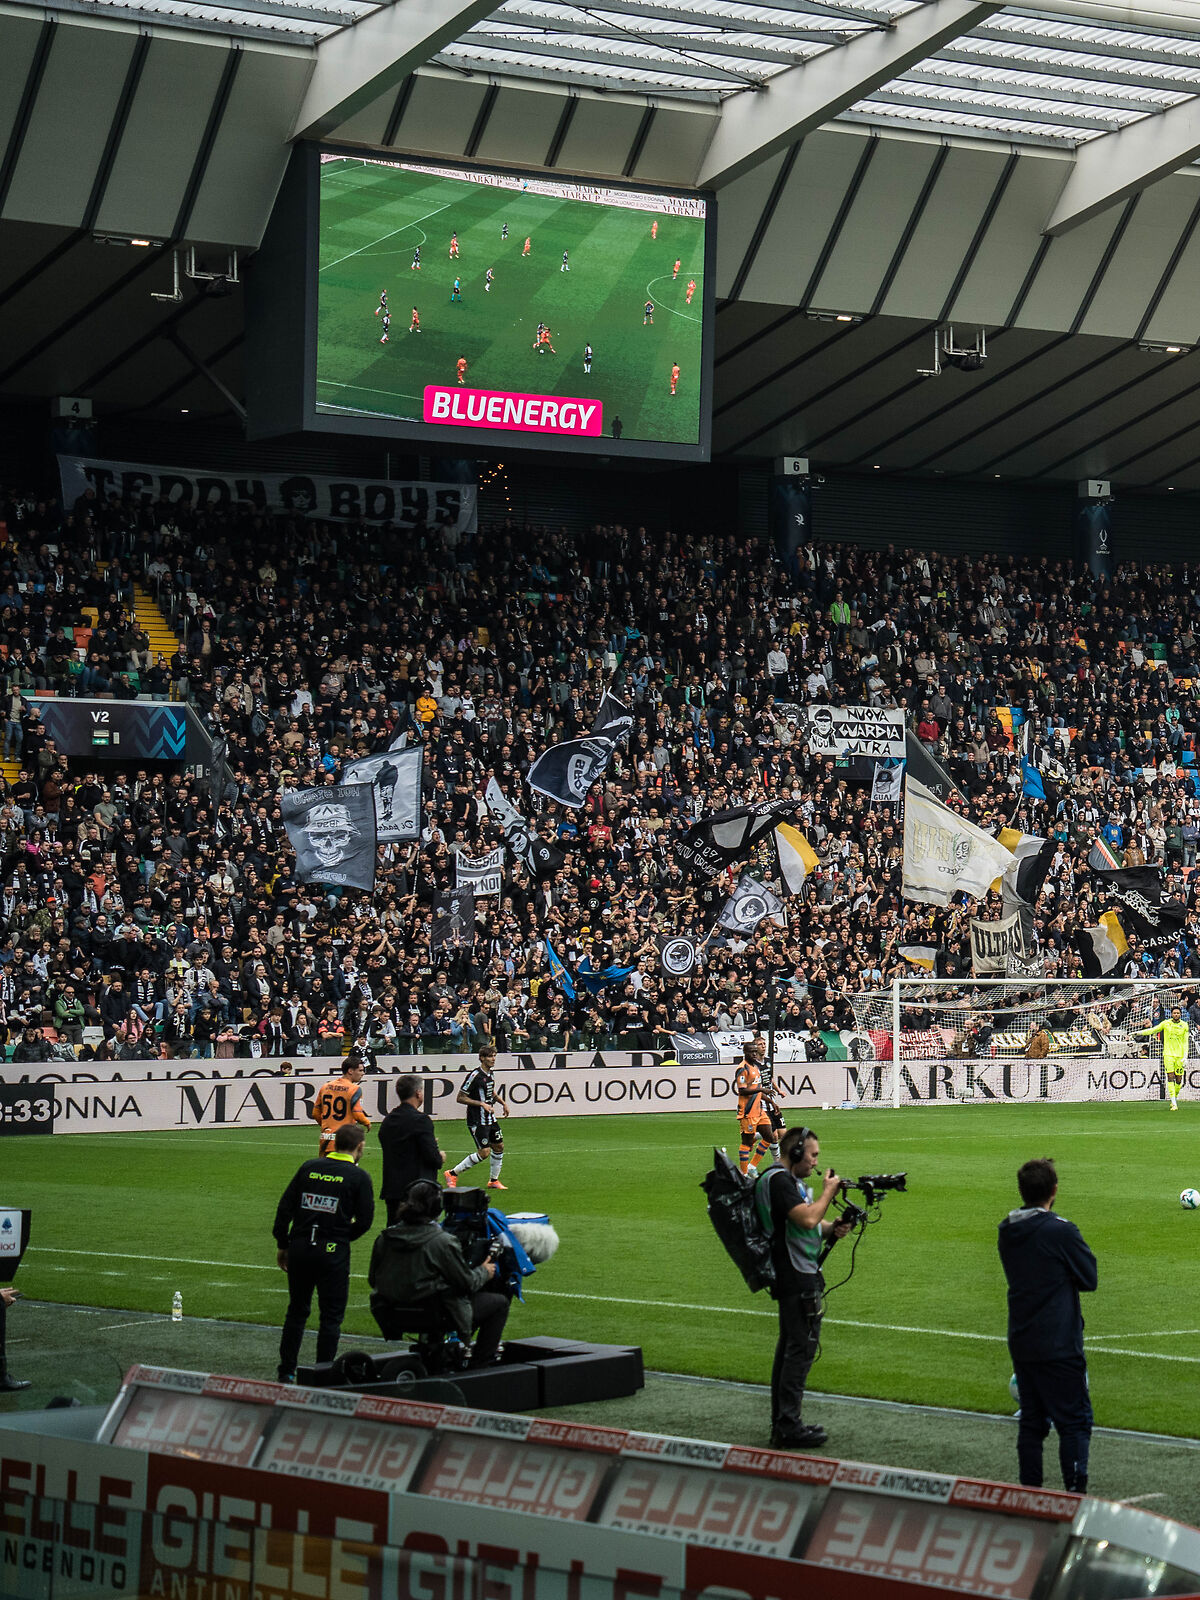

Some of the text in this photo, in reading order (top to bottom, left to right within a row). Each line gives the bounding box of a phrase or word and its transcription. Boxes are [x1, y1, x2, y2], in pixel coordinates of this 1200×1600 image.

[71, 402, 80, 415] 4
[432, 391, 597, 430] BLUENERGY
[792, 460, 800, 473] 6
[86, 466, 461, 523] TEDDY BOYS
[1096, 483, 1103, 495] 7
[91, 712, 109, 723] V2
[847, 708, 890, 723] NUOVA
[838, 723, 901, 740] GUARDIA
[847, 739, 891, 755] ULTRA
[480, 877, 500, 892] NOI
[971, 919, 1021, 959] ULTRAS
[174, 1078, 455, 1125] MARUP
[585, 1078, 677, 1102] UOMO
[687, 1078, 702, 1099] E
[711, 1075, 817, 1098] DNA
[841, 1064, 1065, 1102] MARKUP
[1088, 1069, 1162, 1091] MODA
[0, 1099, 51, 1122] :33
[322, 1094, 347, 1121] 59
[309, 1171, 344, 1184] GIVOVA
[313, 1195, 338, 1207] NET
[836, 1464, 880, 1486] GIELLE
[954, 1481, 1003, 1504] GIELLE
[151, 1483, 380, 1600] GIELLE
[4, 1538, 128, 1590] NCENDIO
